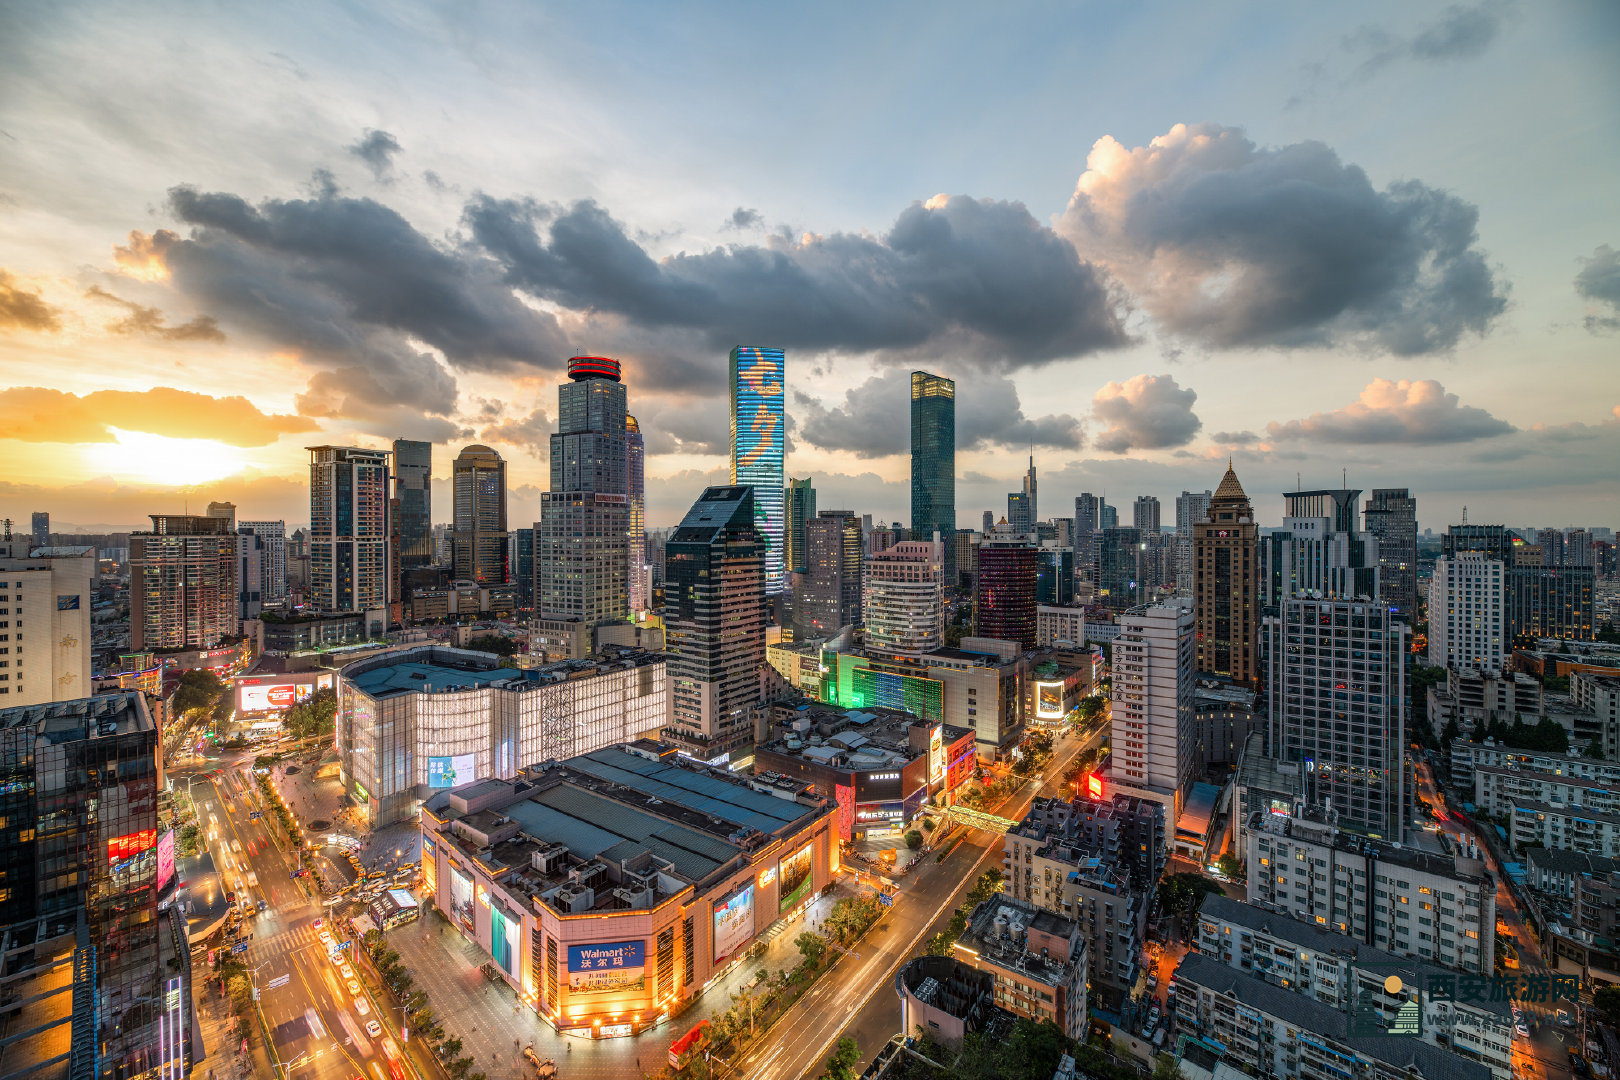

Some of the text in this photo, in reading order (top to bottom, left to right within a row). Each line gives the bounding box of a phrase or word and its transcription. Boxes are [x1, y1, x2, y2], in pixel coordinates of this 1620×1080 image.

[580, 948, 624, 959] Walmart
[581, 957, 624, 968] 沃尔玛
